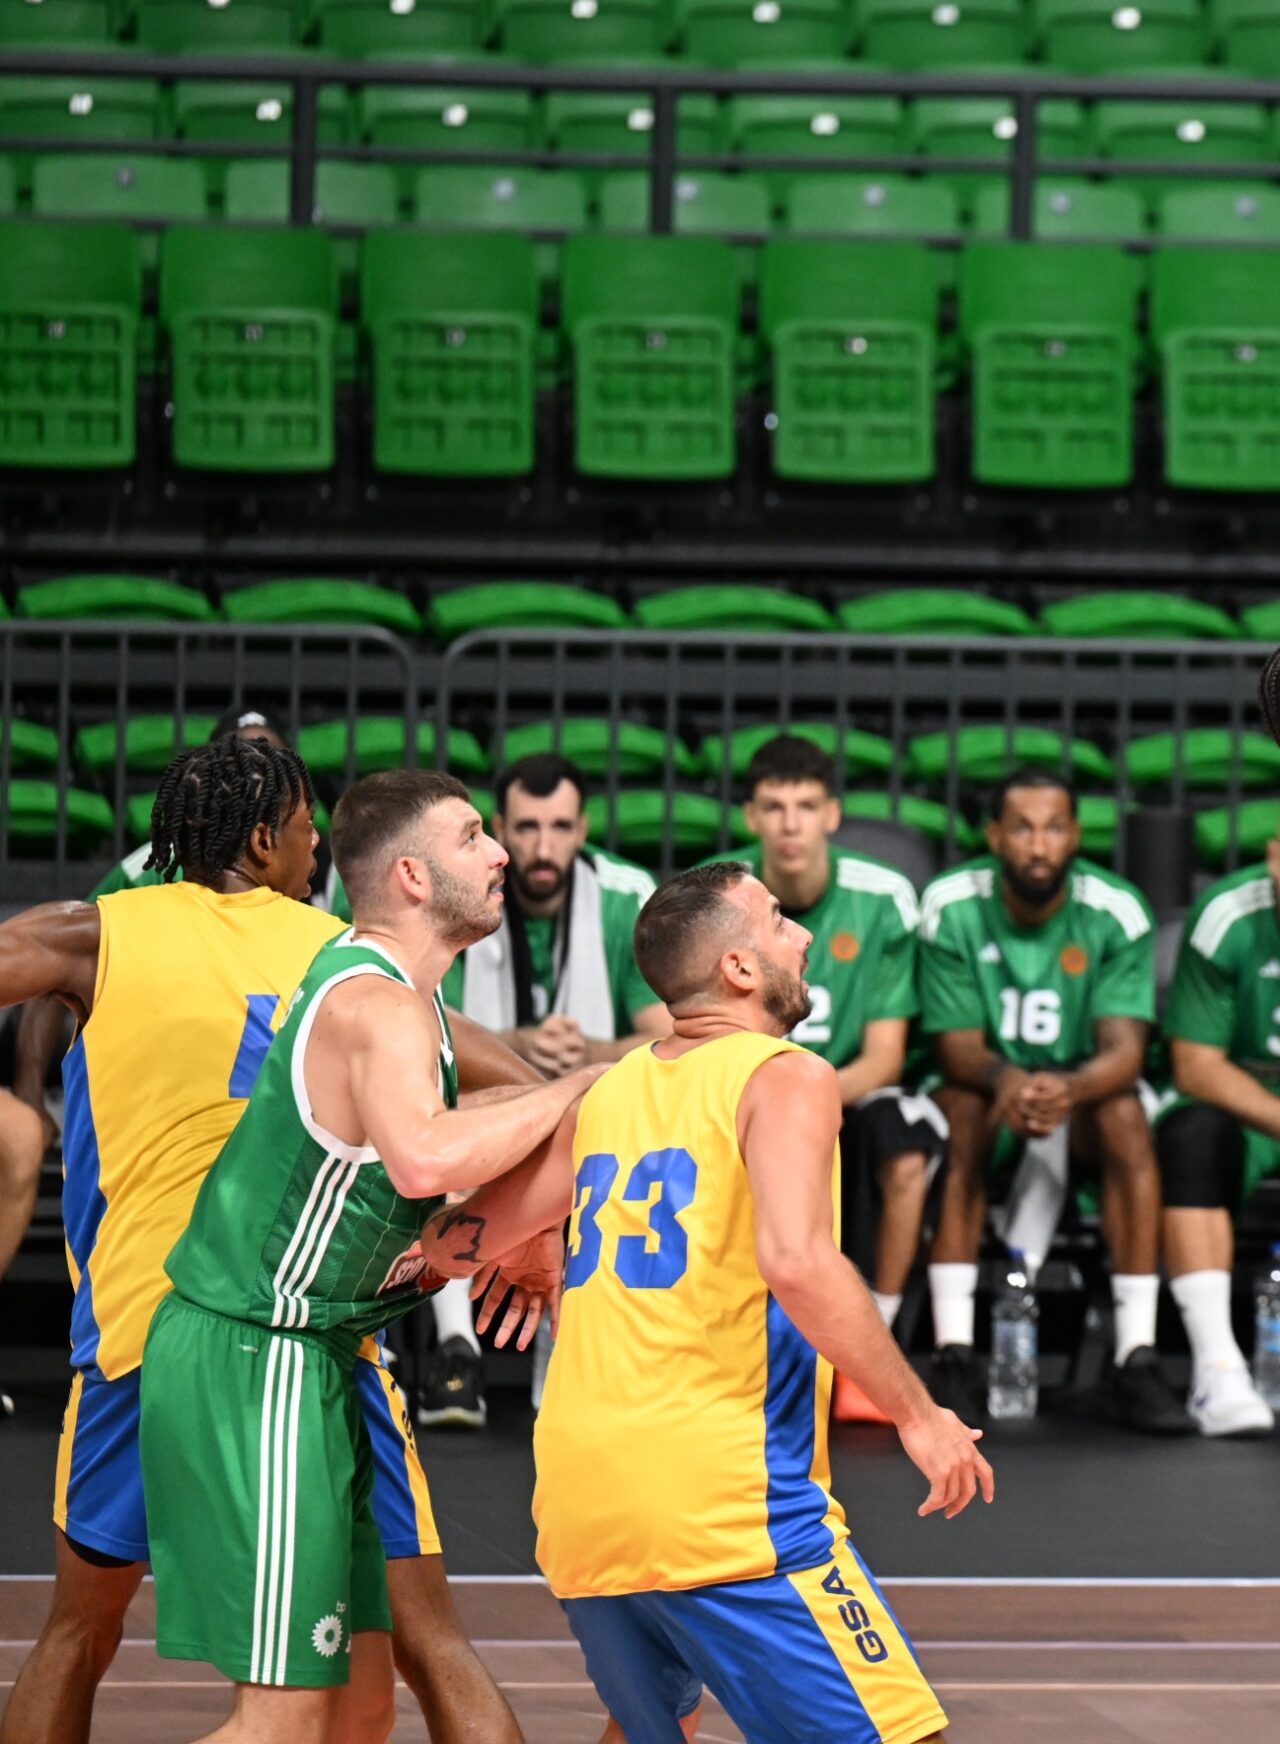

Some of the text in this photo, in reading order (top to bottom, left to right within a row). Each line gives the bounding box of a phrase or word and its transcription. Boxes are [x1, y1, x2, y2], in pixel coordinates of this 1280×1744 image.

[784, 985, 832, 1042] 2
[999, 986, 1062, 1045] 16
[564, 1147, 698, 1290] 33
[820, 1565, 889, 1664] GSA
